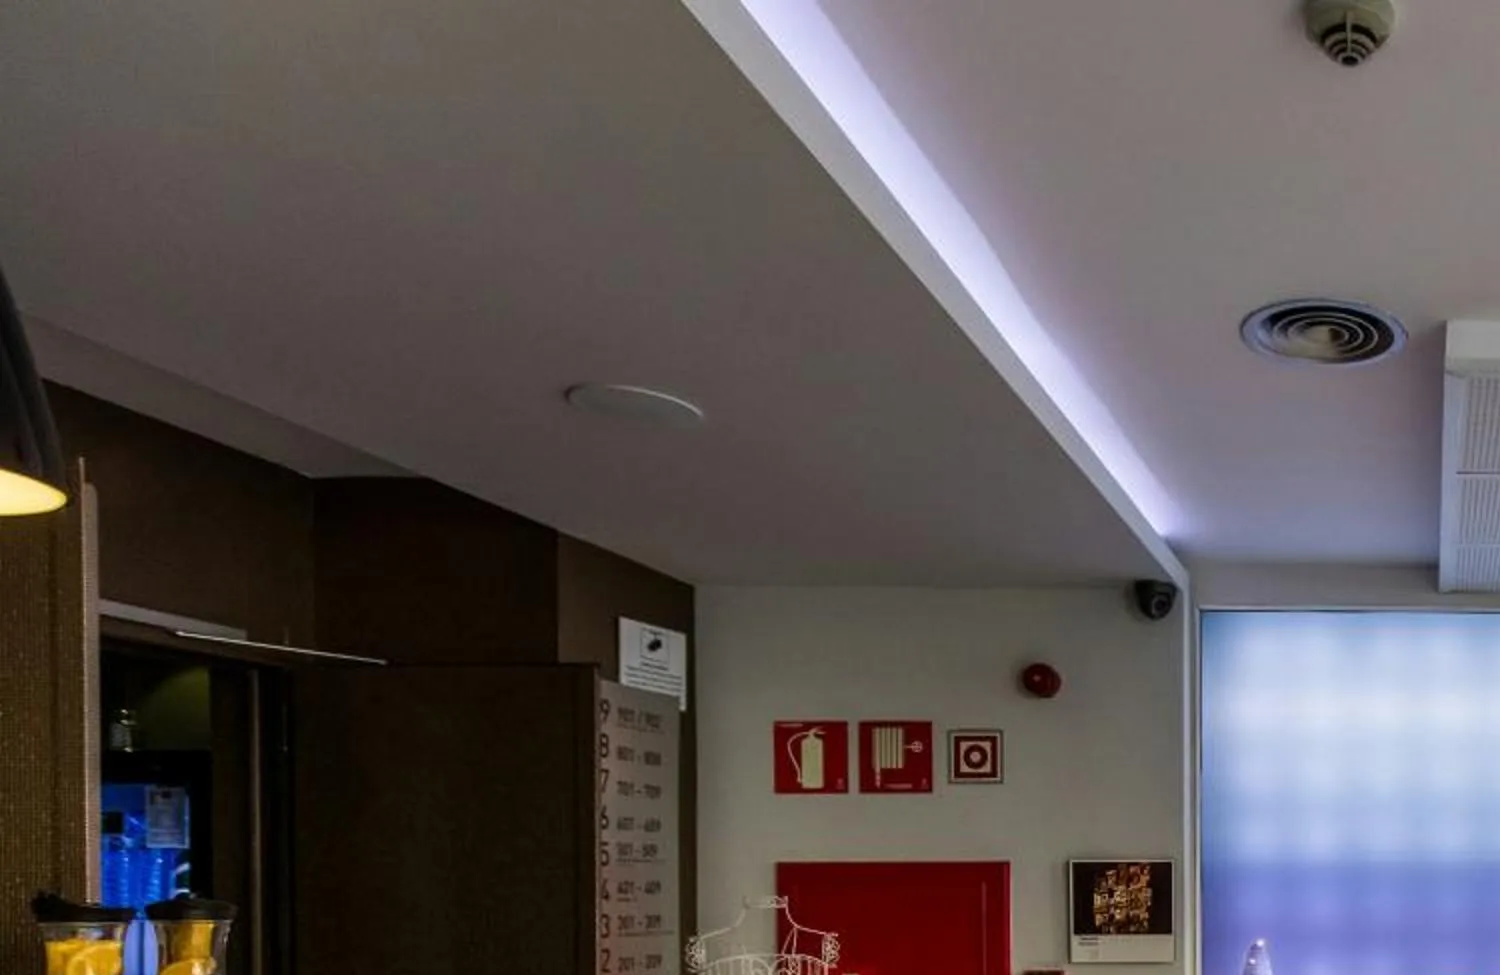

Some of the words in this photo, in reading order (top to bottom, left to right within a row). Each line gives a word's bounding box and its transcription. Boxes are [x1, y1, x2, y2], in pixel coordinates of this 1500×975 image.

[599, 699, 610, 722] 9
[599, 734, 609, 758] 8
[599, 769, 610, 793] 7
[599, 805, 610, 830] 6
[599, 841, 610, 866] 5
[600, 914, 611, 939] 3
[601, 949, 611, 973] 2
